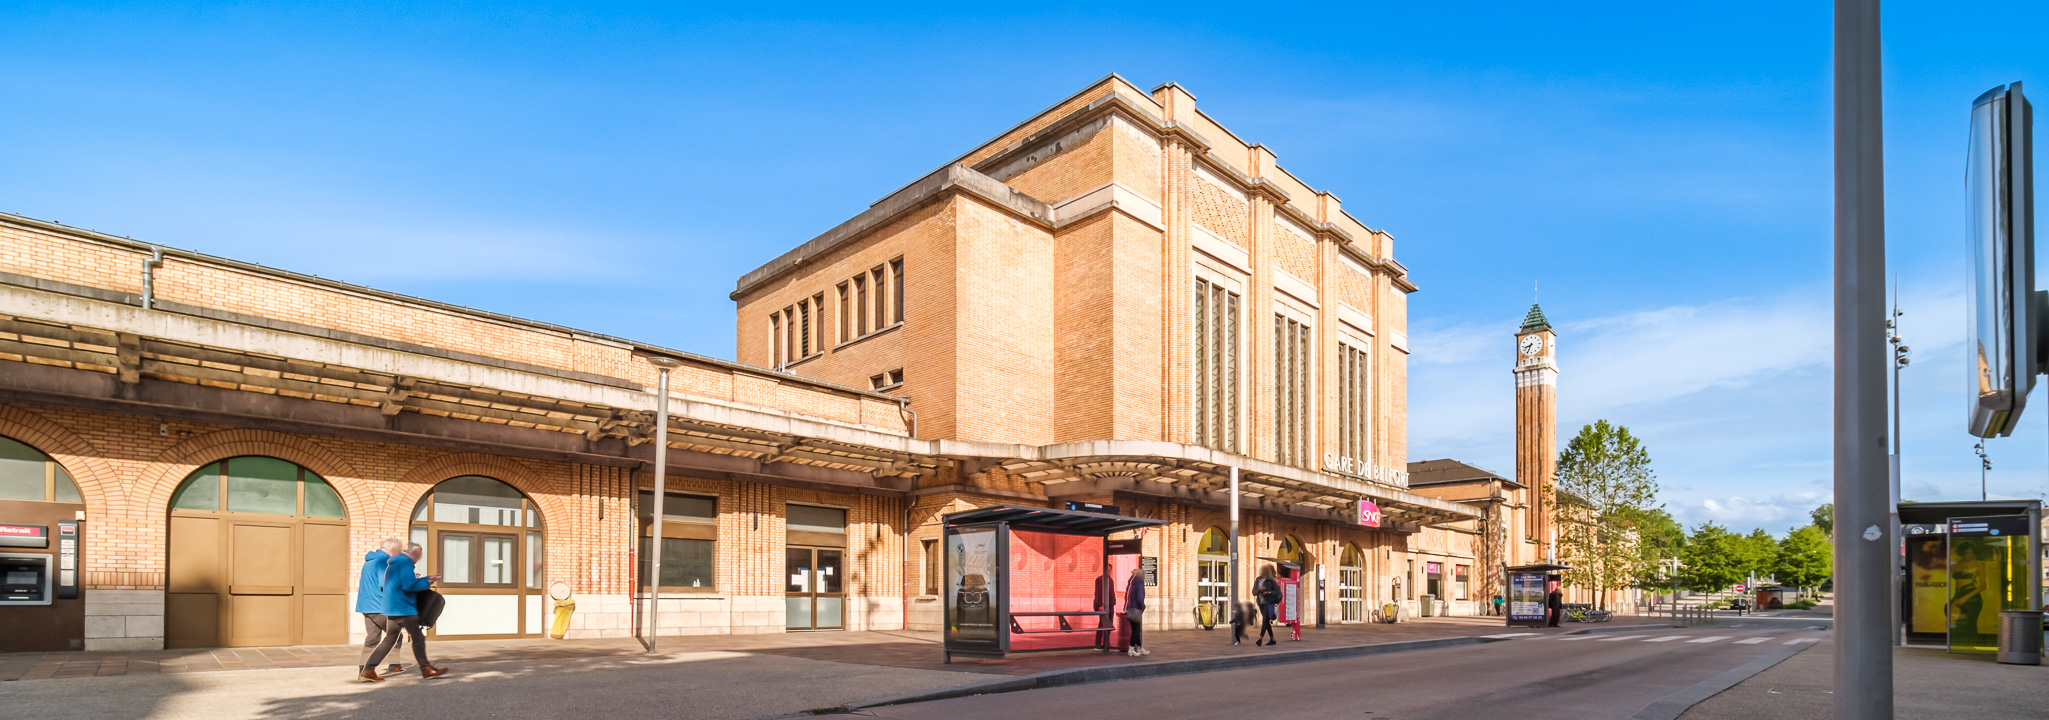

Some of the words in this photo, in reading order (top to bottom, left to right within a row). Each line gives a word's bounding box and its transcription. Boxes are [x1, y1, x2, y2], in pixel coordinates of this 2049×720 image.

[1323, 452, 1353, 474] GARE
[1357, 460, 1369, 479] DE
[1373, 464, 1410, 487] BELFORT
[1361, 510, 1381, 523] SNCF
[0, 526, 31, 534] Retrait
